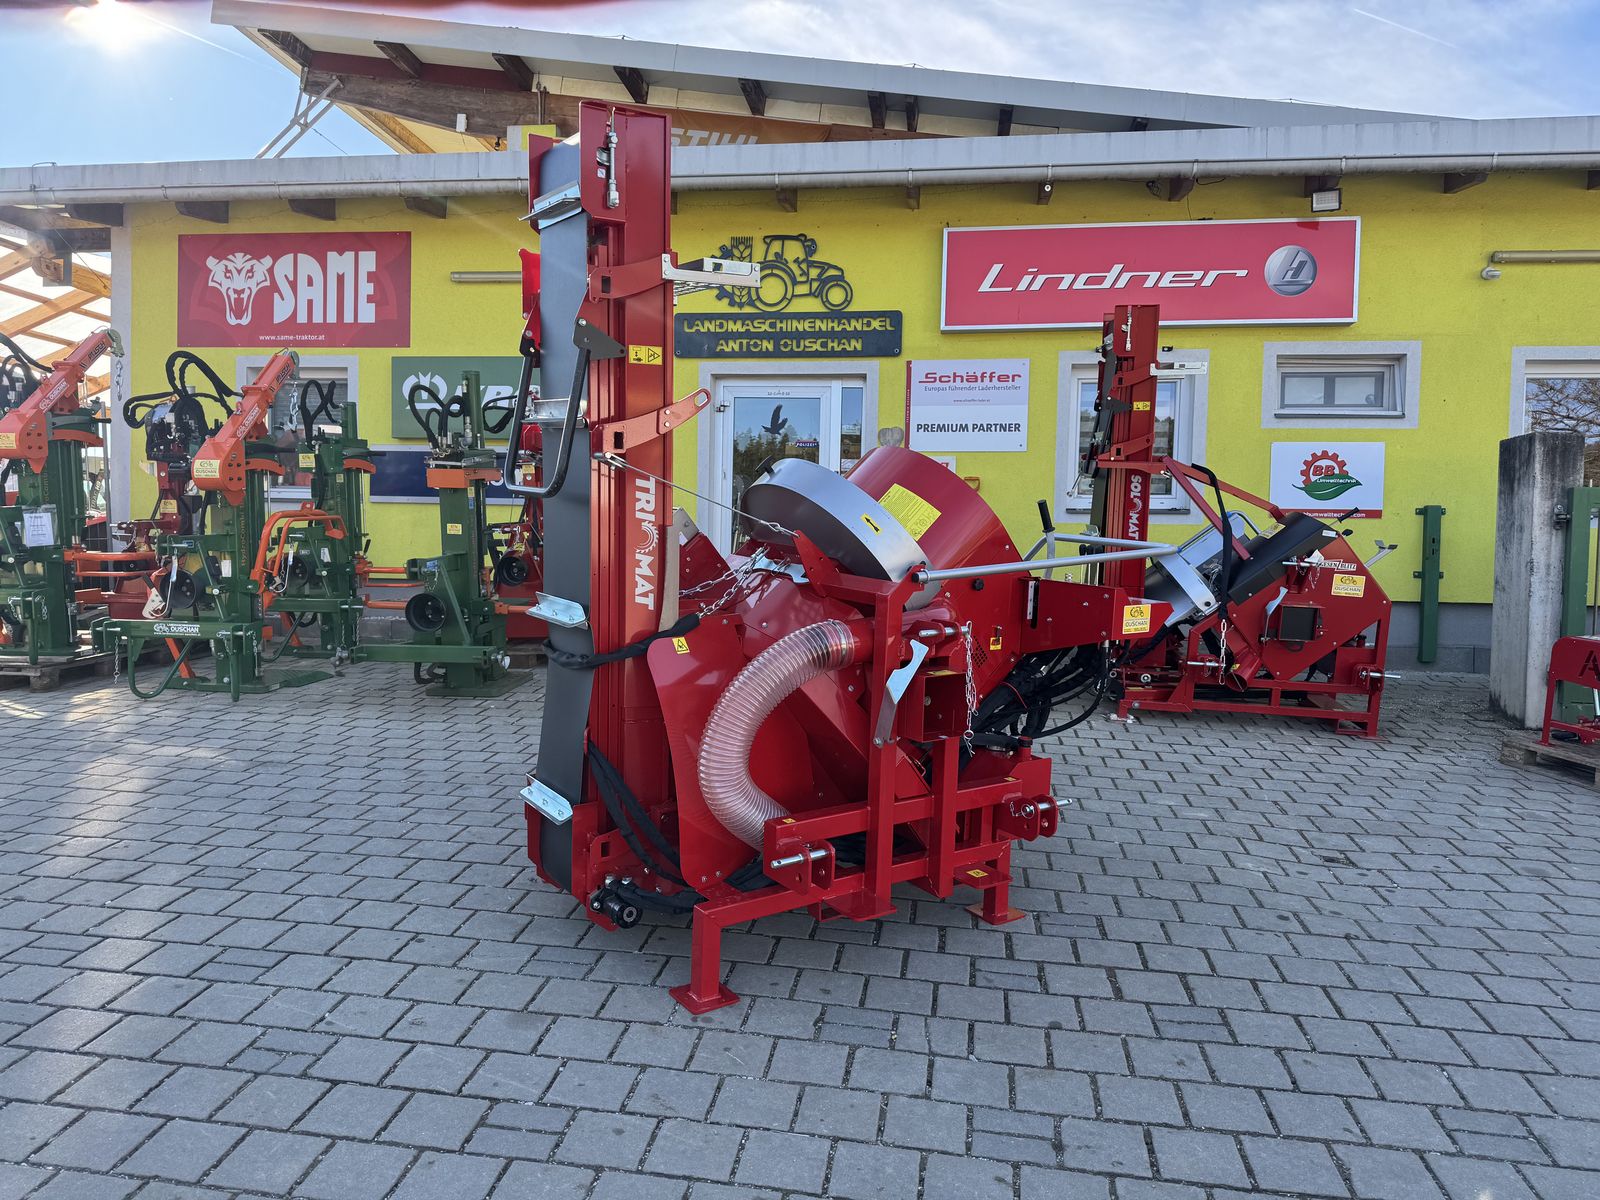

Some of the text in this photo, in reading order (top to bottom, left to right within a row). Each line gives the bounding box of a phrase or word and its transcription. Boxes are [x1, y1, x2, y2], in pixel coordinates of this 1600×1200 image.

[978, 262, 1248, 293] Lindner
[273, 251, 377, 324] SAME
[683, 317, 895, 332] LANDMASCHINENHANDEL
[259, 333, 325, 342] www.same-traktor.at
[716, 338, 862, 352] ANTON OUSCHAN
[919, 371, 1022, 384] Schäffer
[916, 423, 1021, 433] PREMIUM PARTNER
[1312, 464, 1336, 476] BB
[1125, 620, 1148, 628] OUSCHAN
